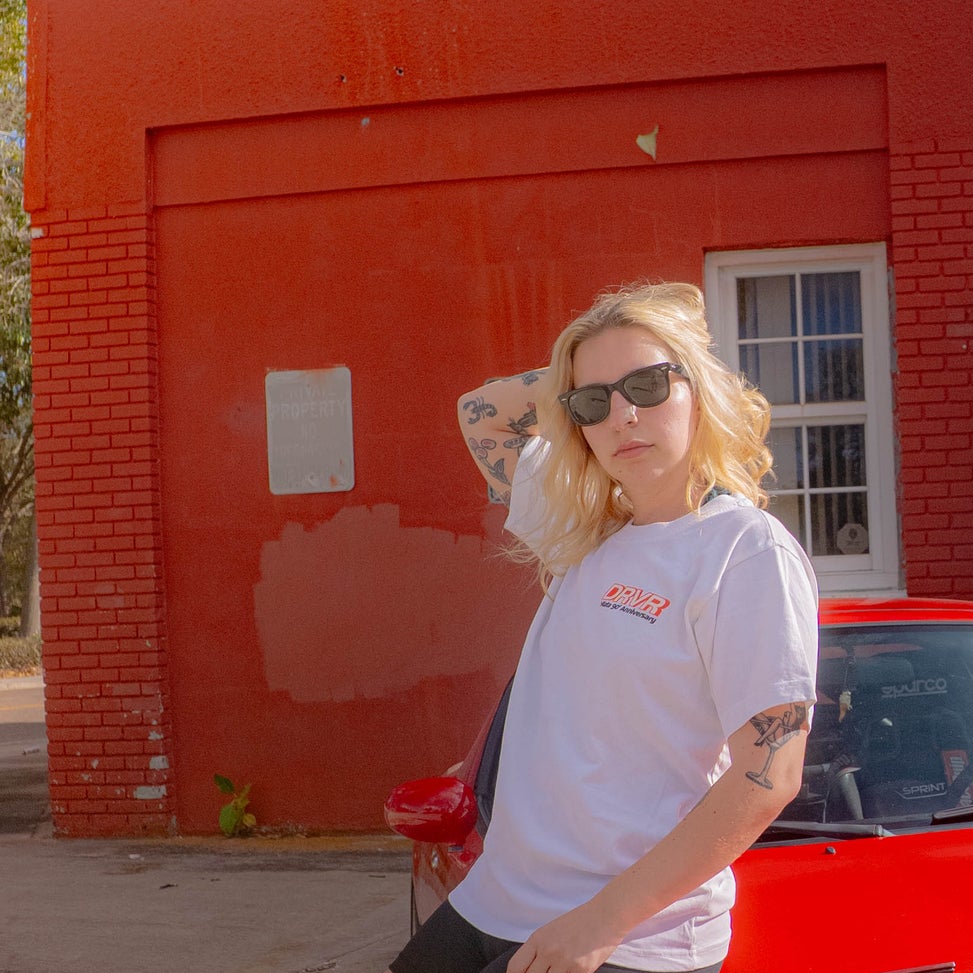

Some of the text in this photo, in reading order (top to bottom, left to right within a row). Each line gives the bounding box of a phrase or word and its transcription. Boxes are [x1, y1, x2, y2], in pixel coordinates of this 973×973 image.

[278, 384, 337, 400] RIVA
[271, 399, 346, 420] PROPERTY
[602, 582, 671, 617] DRVR
[620, 606, 657, 624] Anniversary
[902, 782, 946, 795] SPRINT
